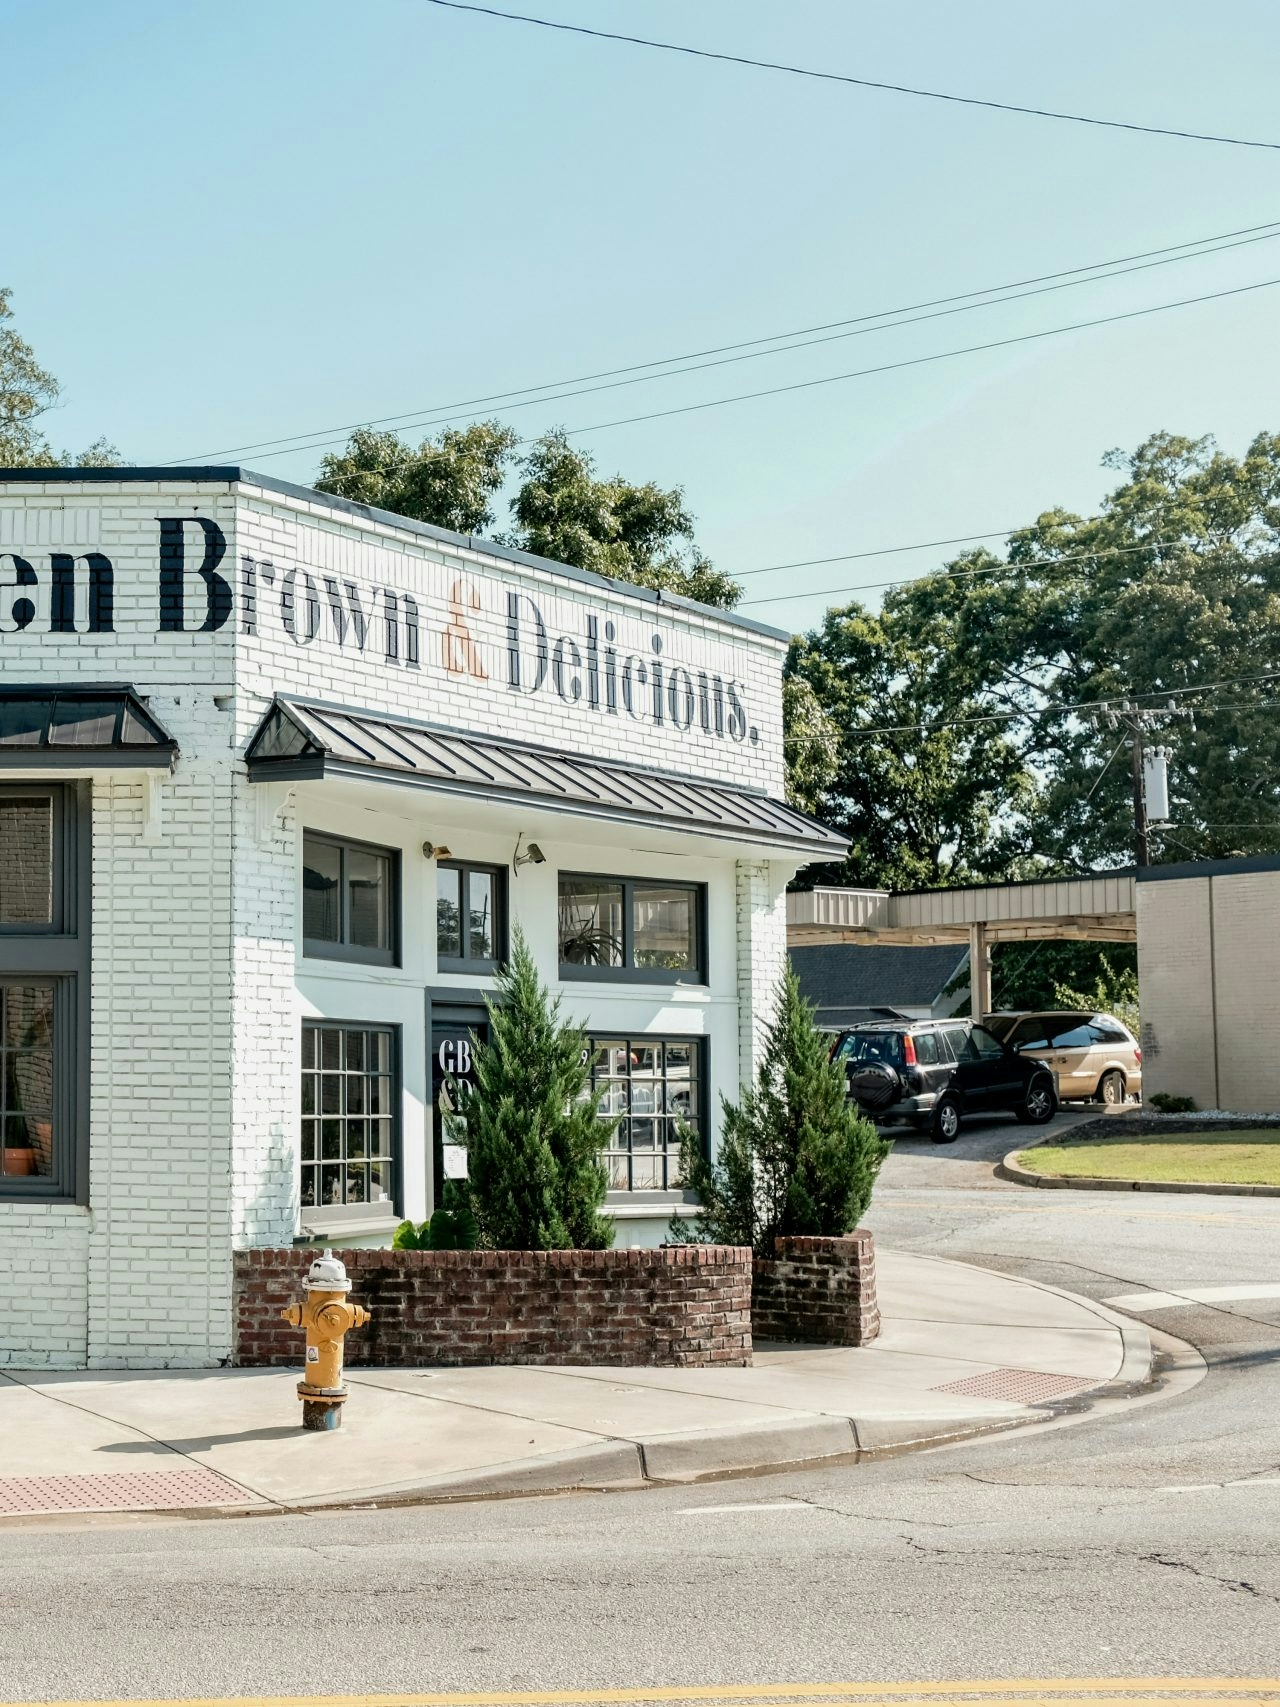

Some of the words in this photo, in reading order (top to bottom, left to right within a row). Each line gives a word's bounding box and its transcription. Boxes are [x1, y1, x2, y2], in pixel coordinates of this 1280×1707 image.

[155, 517, 421, 671] Brown
[441, 578, 489, 683] &
[505, 590, 760, 747] Delicious.
[438, 1039, 471, 1073] GB
